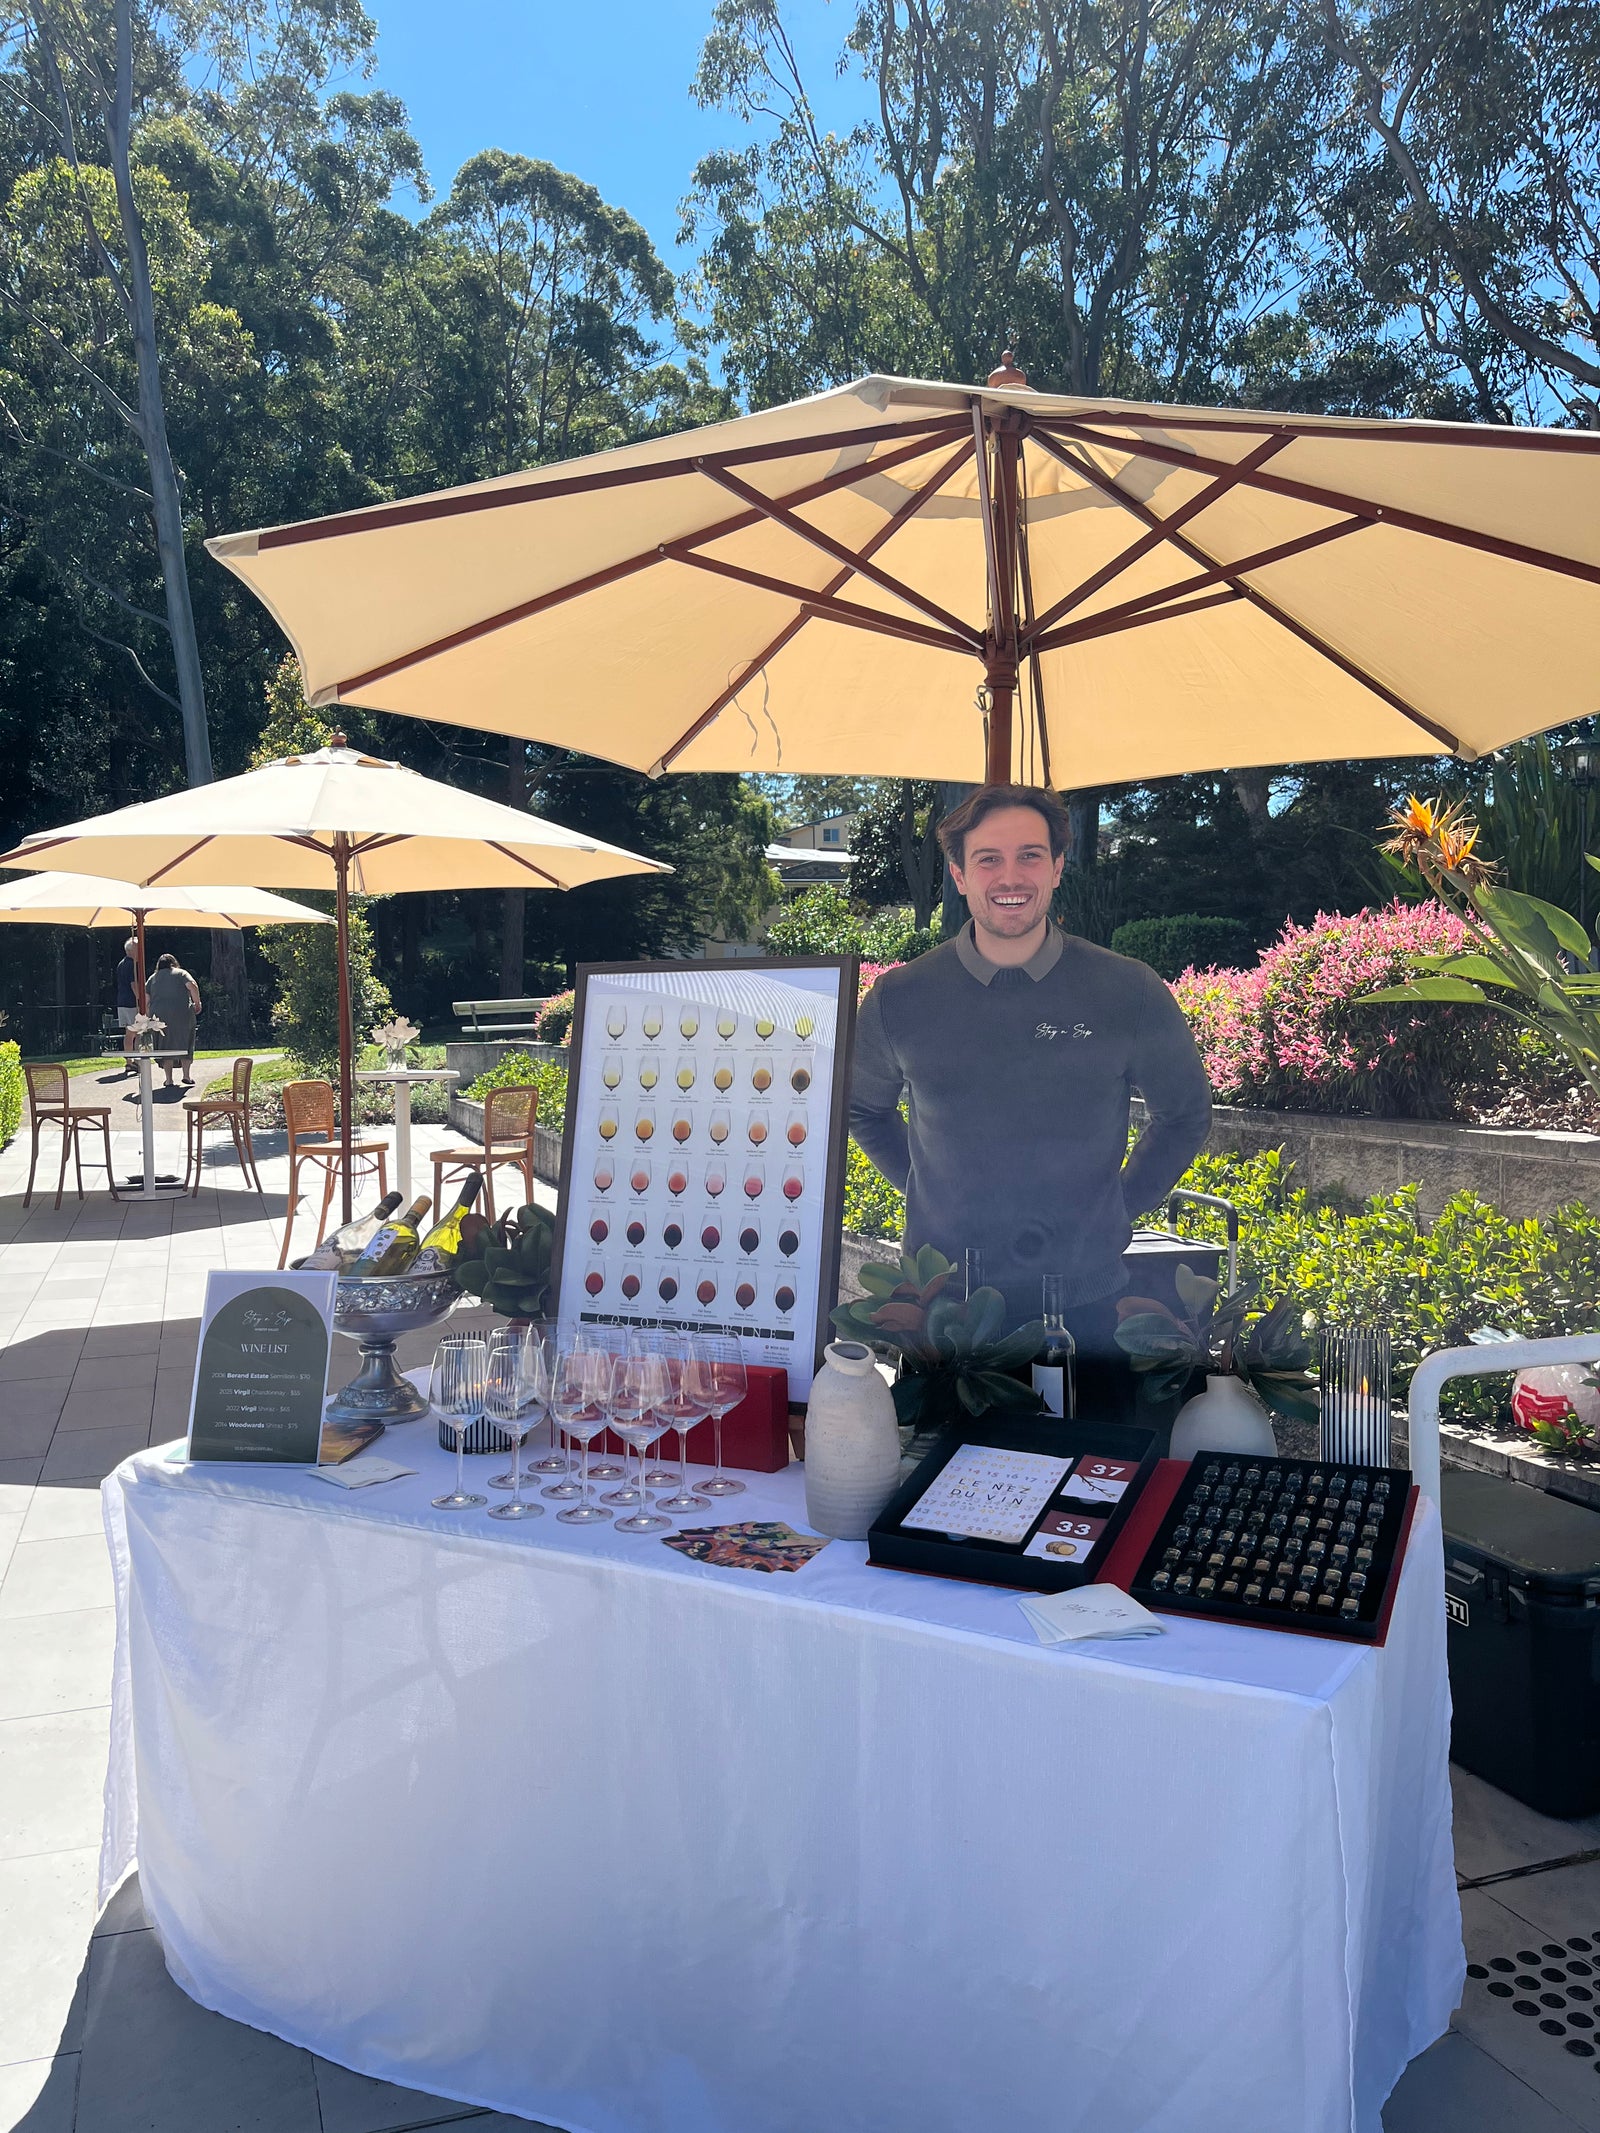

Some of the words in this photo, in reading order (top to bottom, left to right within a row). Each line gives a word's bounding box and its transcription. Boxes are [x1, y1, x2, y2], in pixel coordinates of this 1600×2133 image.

[1034, 1022, 1057, 1040] Stay
[1072, 1022, 1093, 1039] Sip
[242, 1309, 262, 1328] Stay
[275, 1310, 293, 1326] Sip
[597, 1314, 663, 1328] COLOR
[680, 1320, 703, 1332] OF
[723, 1324, 777, 1339] WINE
[241, 1343, 267, 1353] WINE
[268, 1343, 289, 1354] LIST
[234, 1388, 251, 1396] Virgil
[1090, 1464, 1126, 1477] 37
[958, 1478, 982, 1488] LE
[991, 1482, 1031, 1494] NEZ
[950, 1488, 976, 1499] DU
[986, 1493, 1024, 1505] VIN
[1055, 1520, 1092, 1536] 33
